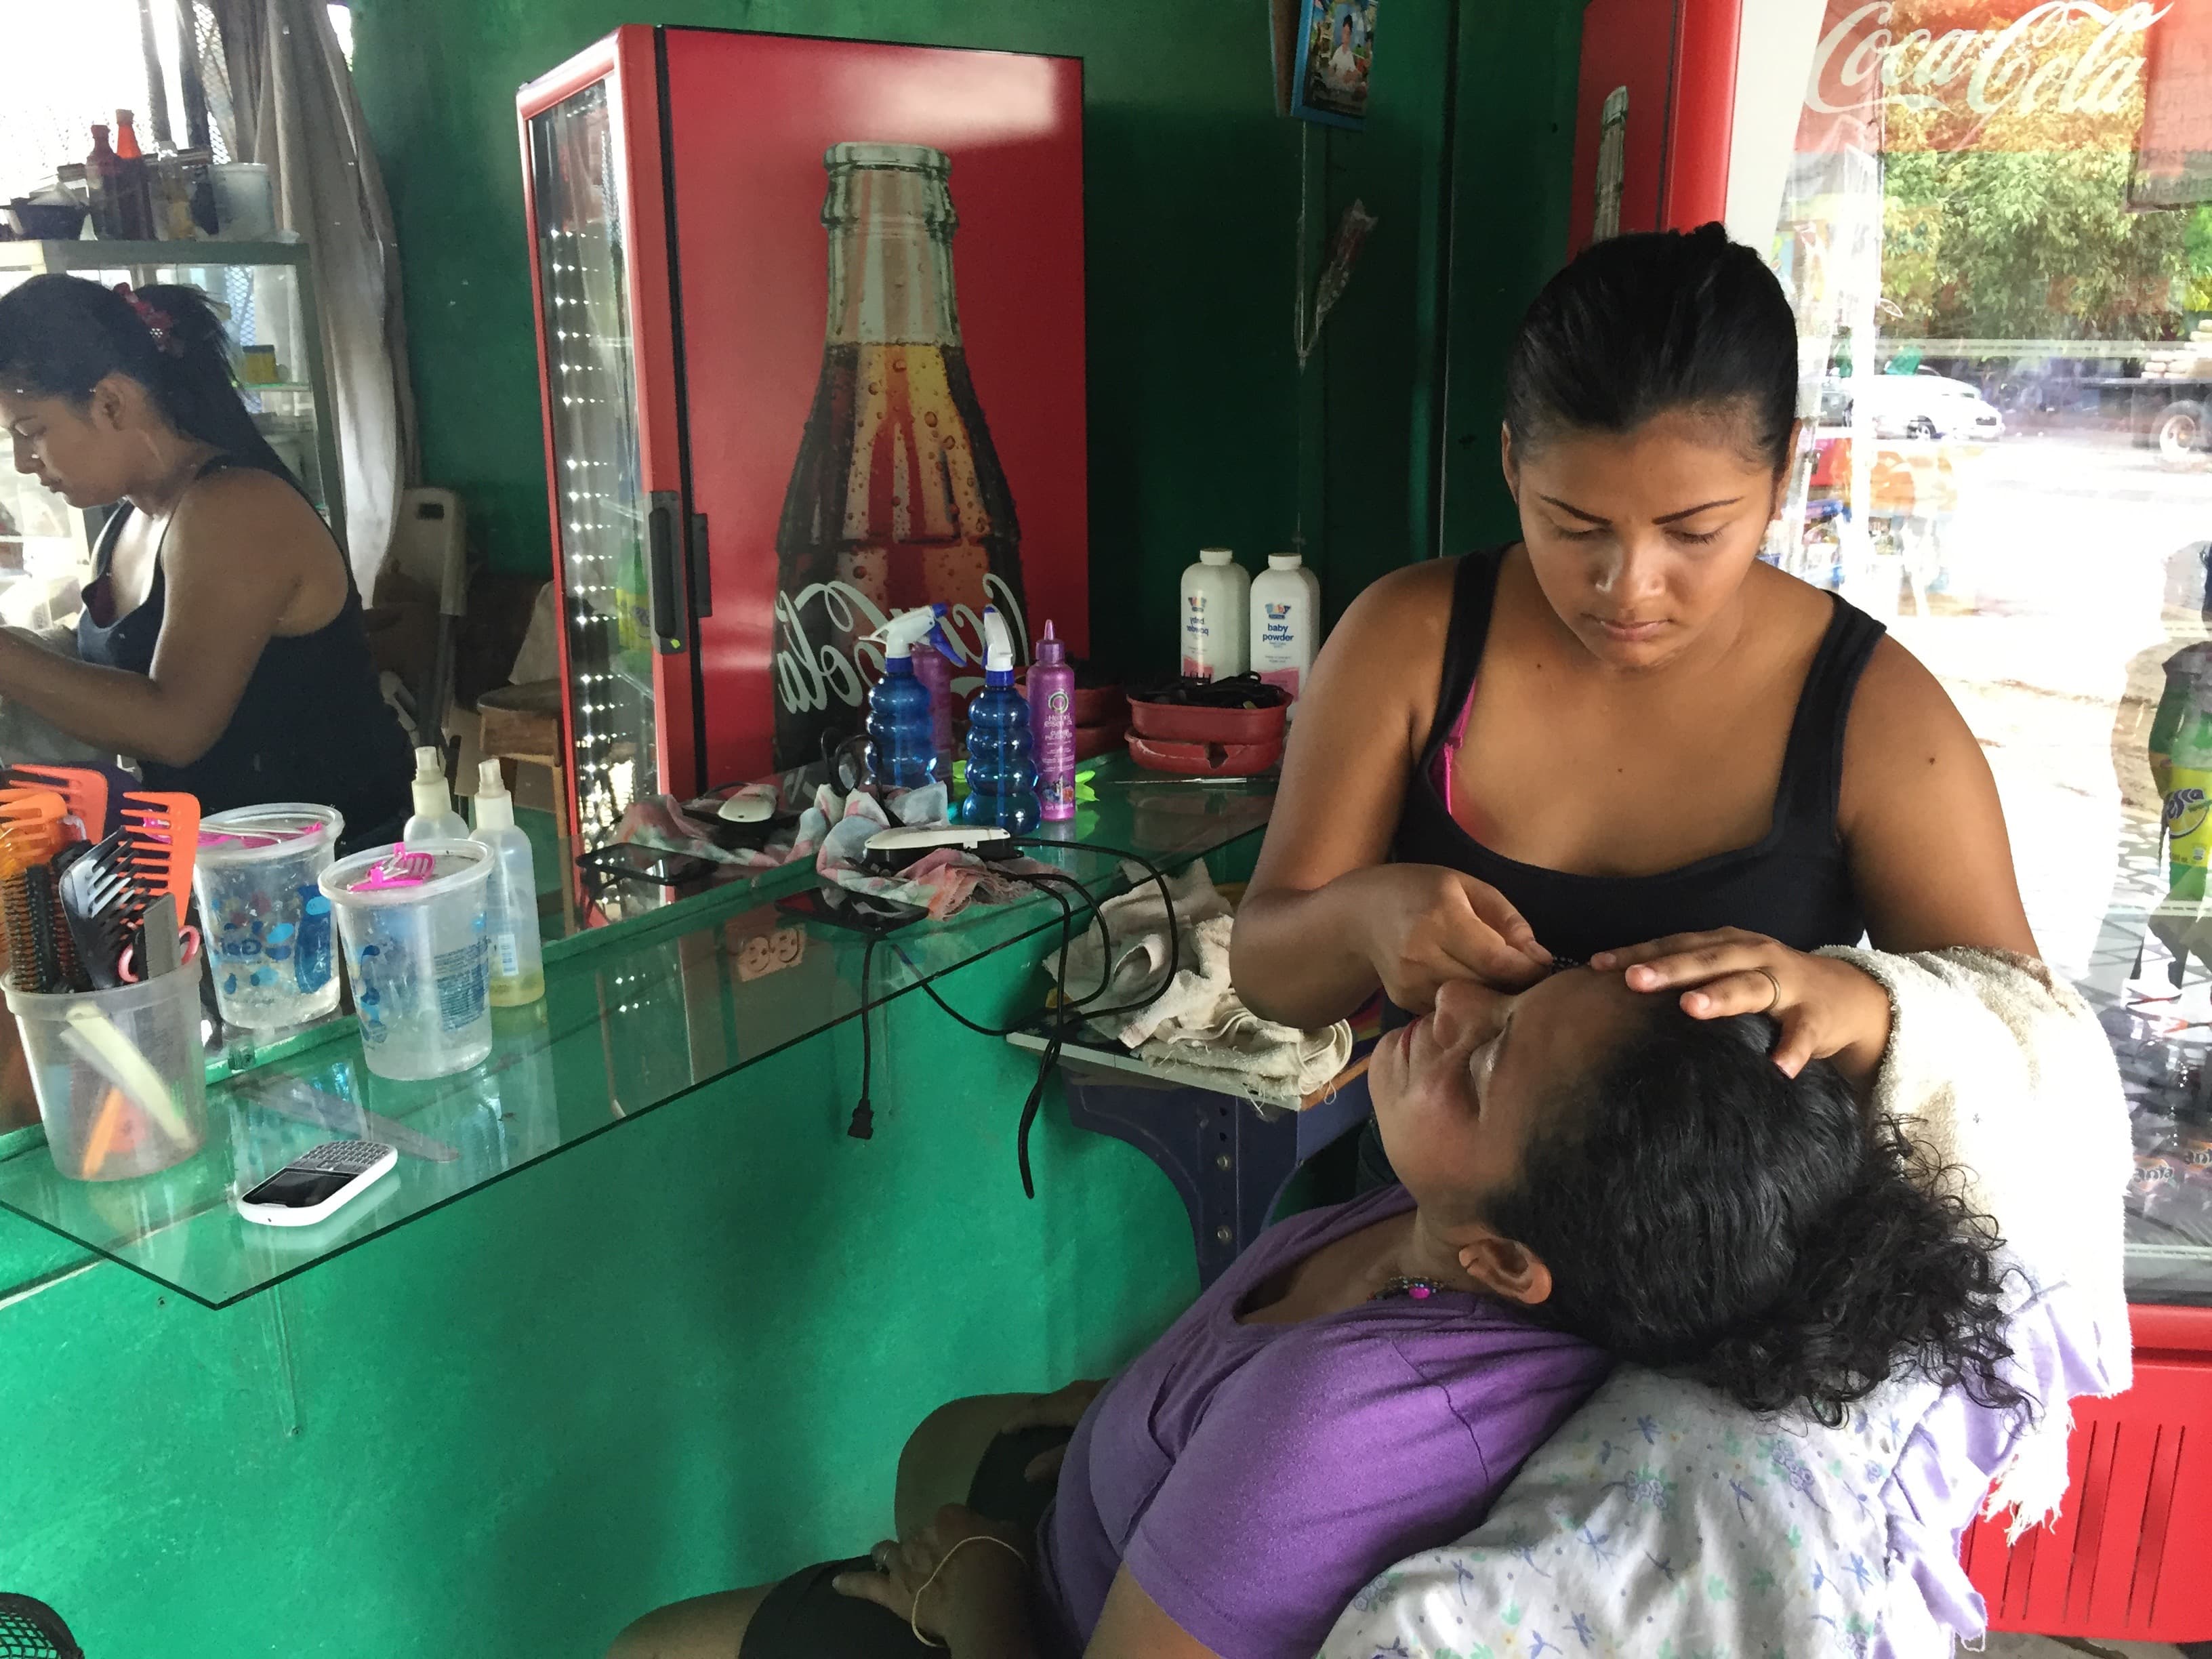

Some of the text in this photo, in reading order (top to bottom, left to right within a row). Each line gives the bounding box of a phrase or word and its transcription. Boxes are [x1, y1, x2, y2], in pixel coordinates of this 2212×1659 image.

[1268, 623, 1288, 634] baby
[1263, 633, 1294, 642] powder
[2133, 1165, 2174, 1183] anta
